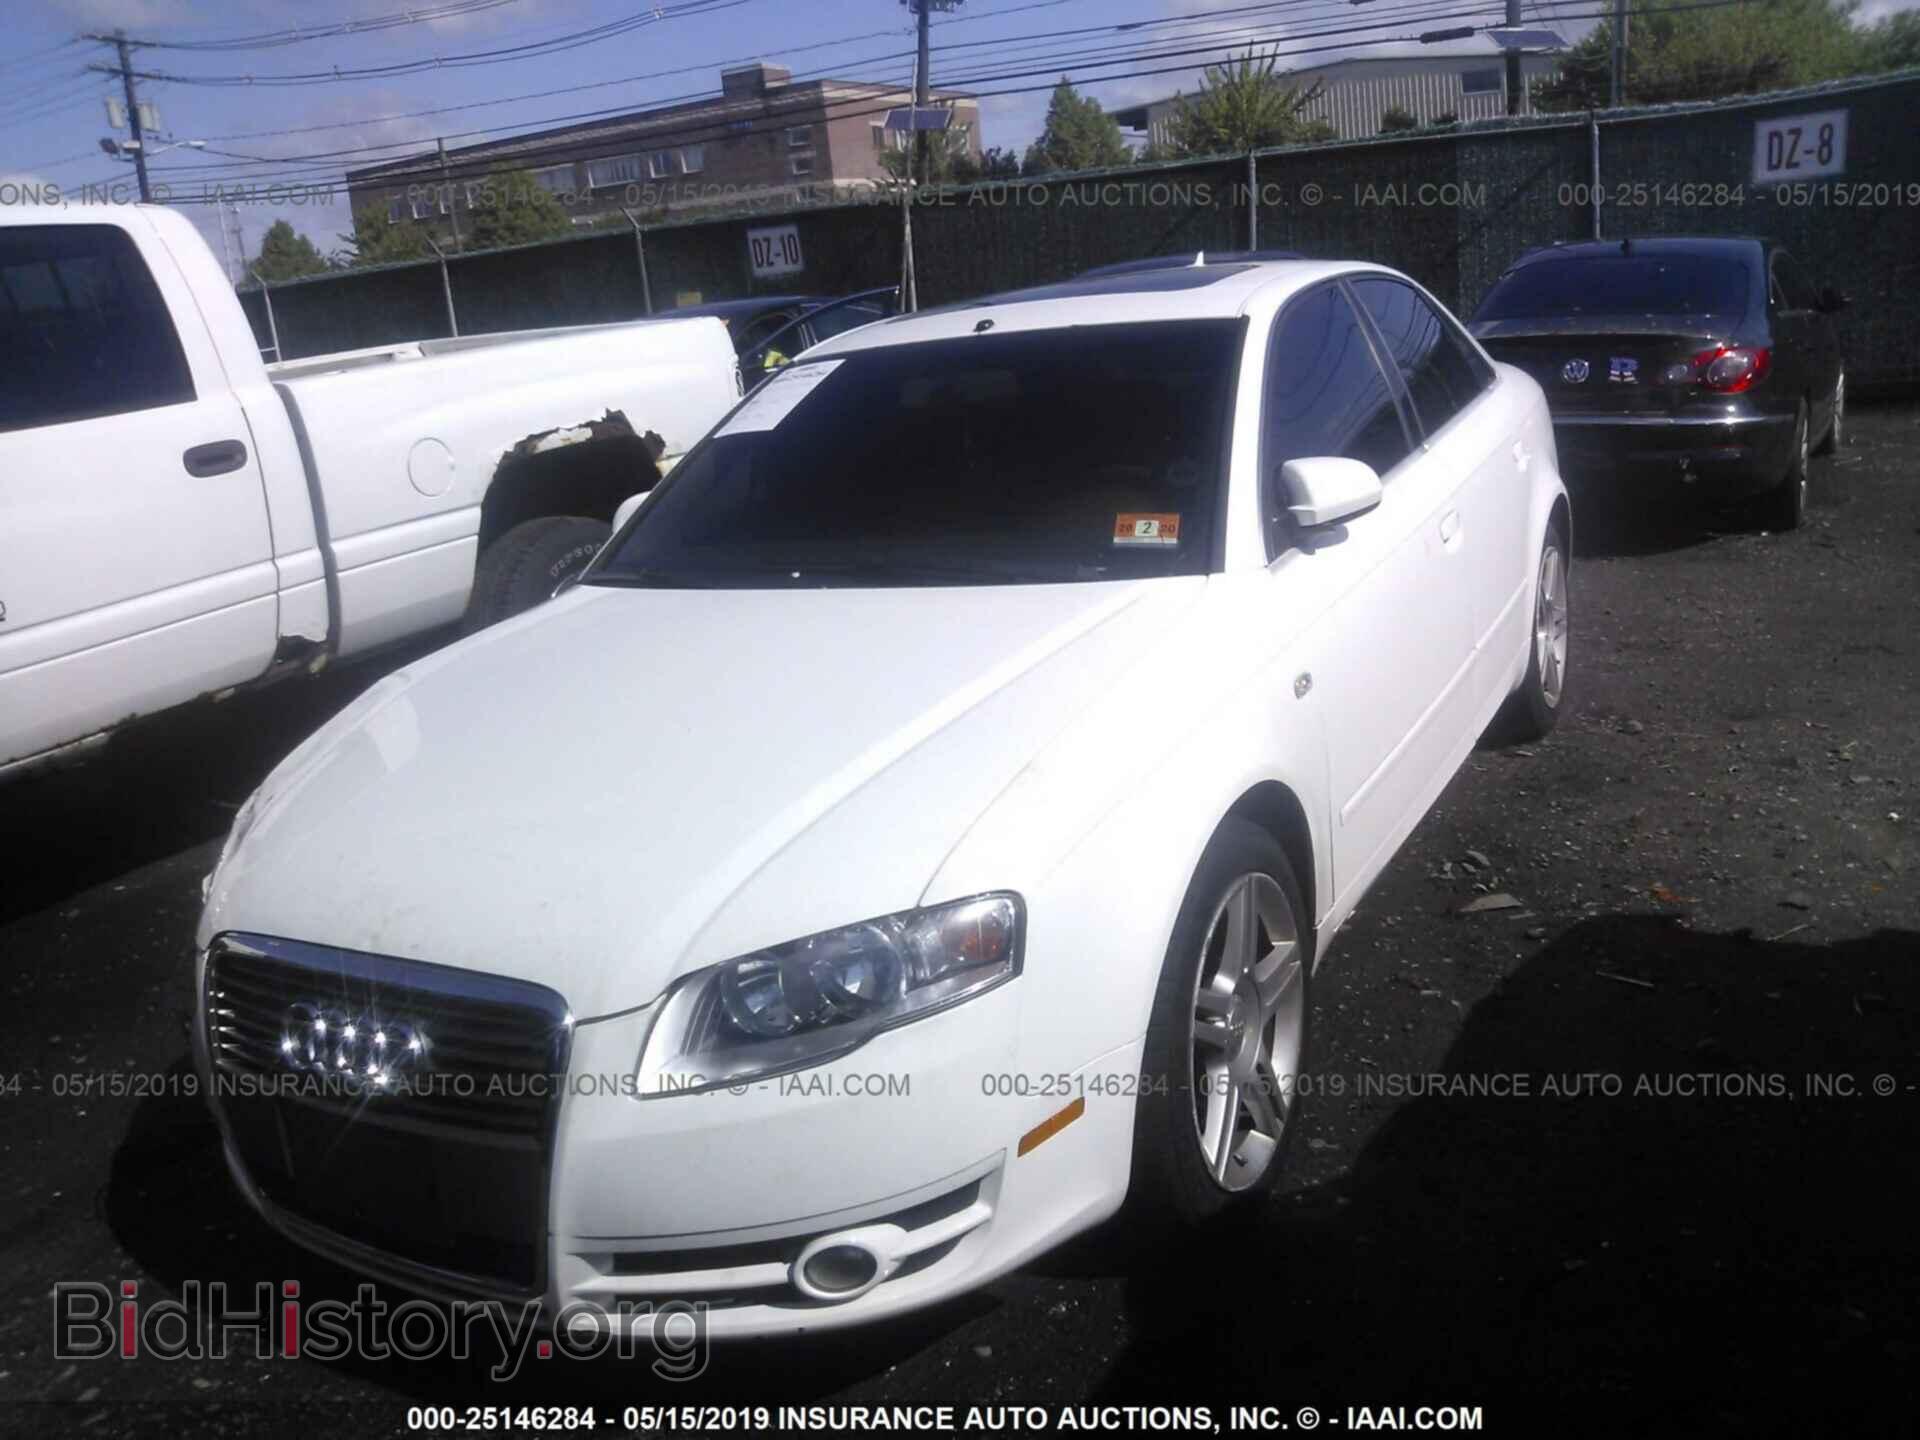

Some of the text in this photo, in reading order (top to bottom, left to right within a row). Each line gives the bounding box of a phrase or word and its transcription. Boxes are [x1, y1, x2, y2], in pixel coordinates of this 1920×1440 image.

[1766, 122, 1835, 172] DZ-8
[751, 233, 800, 269] DZ-10
[1141, 521, 1152, 534] 2
